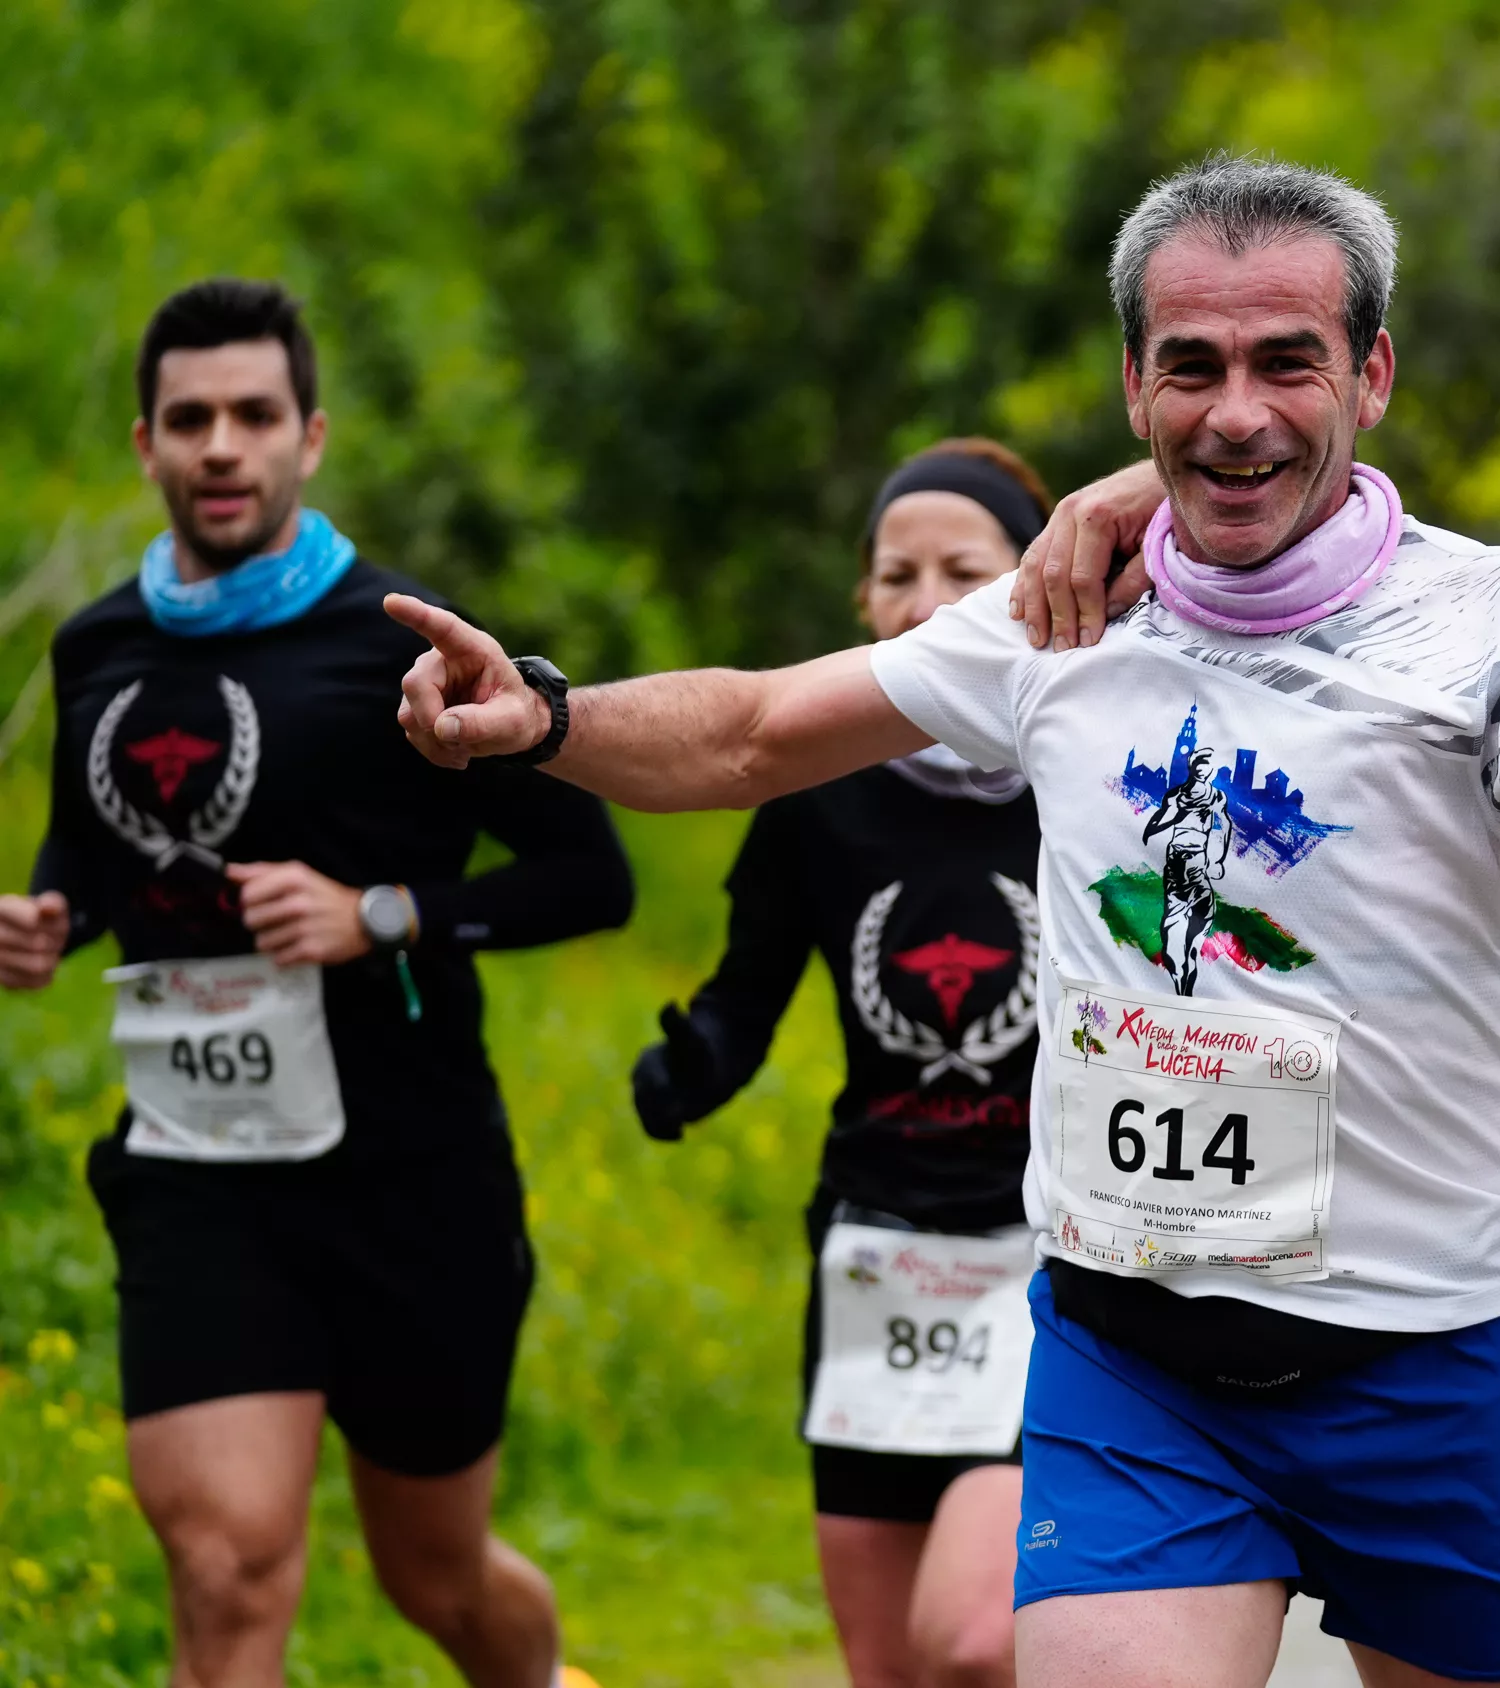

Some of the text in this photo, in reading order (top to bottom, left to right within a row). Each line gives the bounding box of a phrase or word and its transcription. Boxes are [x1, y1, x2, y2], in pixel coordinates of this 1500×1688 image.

[1183, 1024, 1259, 1055] MARATÓN
[171, 1032, 274, 1087] 469
[1145, 1042, 1236, 1083] LUCENA
[1108, 1099, 1255, 1185] 614
[1089, 1189, 1272, 1221] FRANCISCO JAVIER MOYANO MARTÍNEZ
[1143, 1217, 1196, 1233] M-Hombre
[1208, 1250, 1313, 1263] mediamaratonlucena.com
[886, 1314, 994, 1374] 894
[1216, 1369, 1301, 1388] SALOMON
